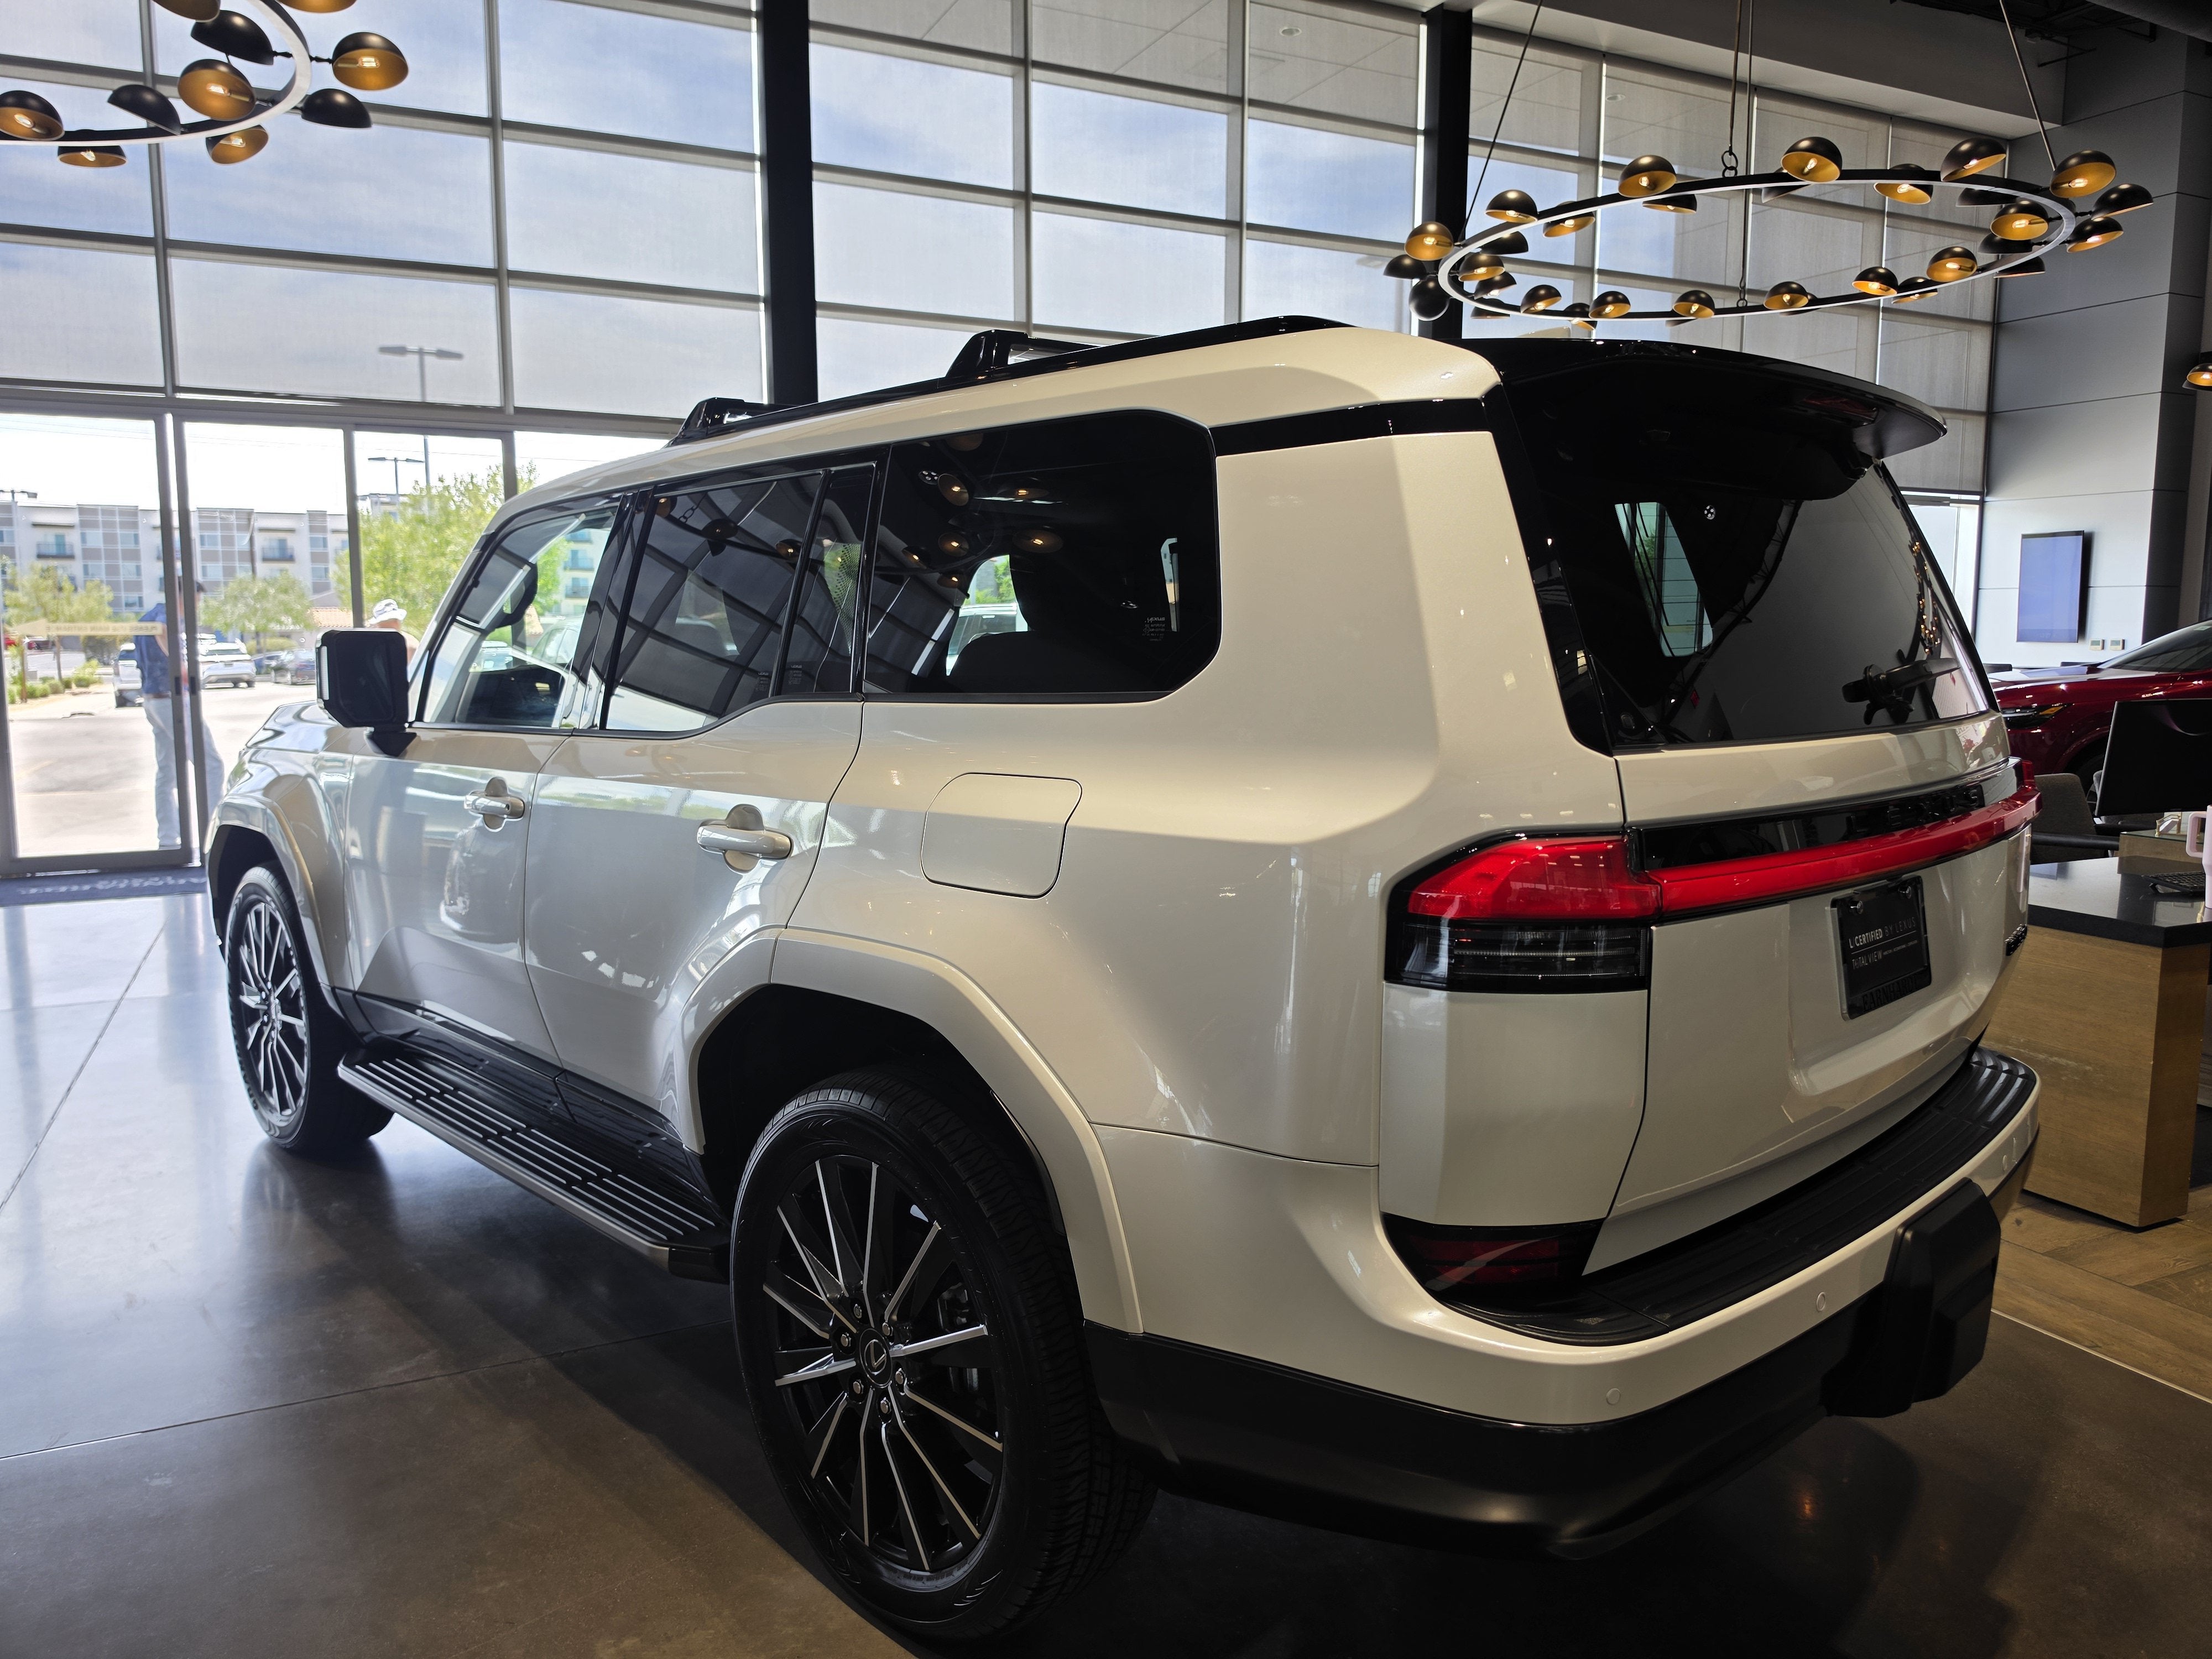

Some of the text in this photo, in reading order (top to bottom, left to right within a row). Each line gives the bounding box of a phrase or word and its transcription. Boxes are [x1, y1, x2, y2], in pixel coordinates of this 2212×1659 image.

[1884, 924, 1893, 937] BY
[1895, 916, 1916, 933] LEXUS
[1851, 949, 1883, 970] TOTAL VIEW
